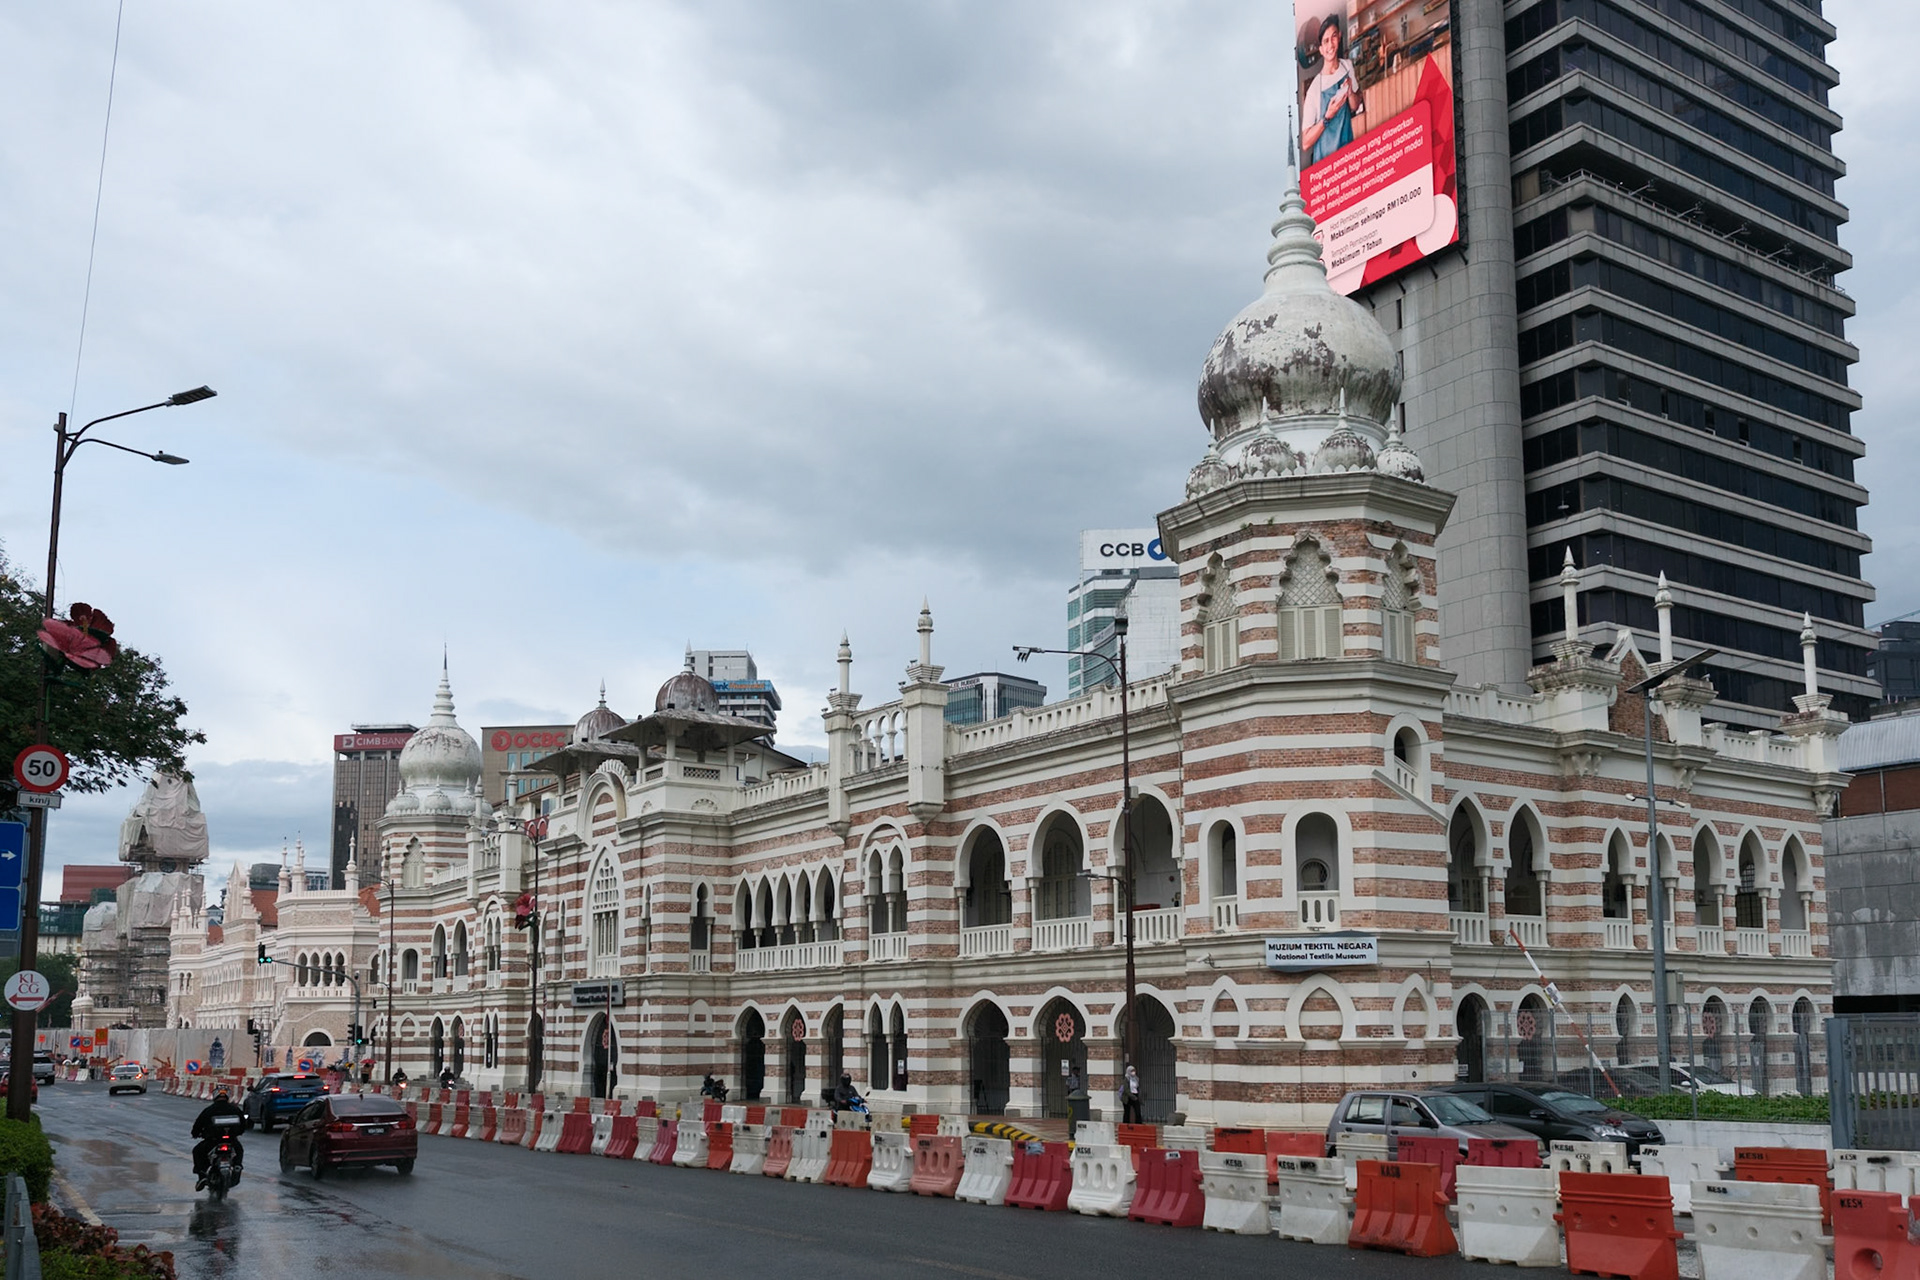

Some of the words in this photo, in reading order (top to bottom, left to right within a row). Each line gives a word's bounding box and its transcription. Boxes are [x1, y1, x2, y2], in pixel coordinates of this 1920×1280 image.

[1310, 165, 1332, 182] Program
[1333, 144, 1366, 170] pembiayaan
[1367, 136, 1382, 151] yang
[1382, 117, 1414, 140] ditawarkan
[1310, 183, 1322, 195] oleh
[1322, 167, 1348, 188] Agrobank
[1348, 159, 1360, 173] bagi
[1362, 143, 1392, 165] membantu
[1393, 125, 1423, 148] usahawan
[1326, 185, 1340, 199] yang
[1340, 166, 1374, 190] memerlukan
[1376, 149, 1403, 170] sokongan
[1404, 136, 1424, 154] modal
[1326, 186, 1361, 210] menjalankan
[1330, 222, 1360, 242] Maksimum
[1360, 208, 1386, 226] sehingga
[1387, 187, 1422, 211] RM100,000
[1340, 206, 1368, 224] Pembiayaan
[1350, 229, 1378, 246] Pembiayaan
[1332, 249, 1360, 269] Maksimum
[1366, 238, 1382, 251] Tahun
[1100, 543, 1144, 557] CCB
[356, 737, 381, 746] CIMB
[382, 736, 408, 746] BANK
[514, 732, 566, 748] OCBC
[28, 760, 55, 777] 50
[30, 796, 50, 806] km/j
[19, 974, 39, 984] KL
[18, 984, 40, 994] CG
